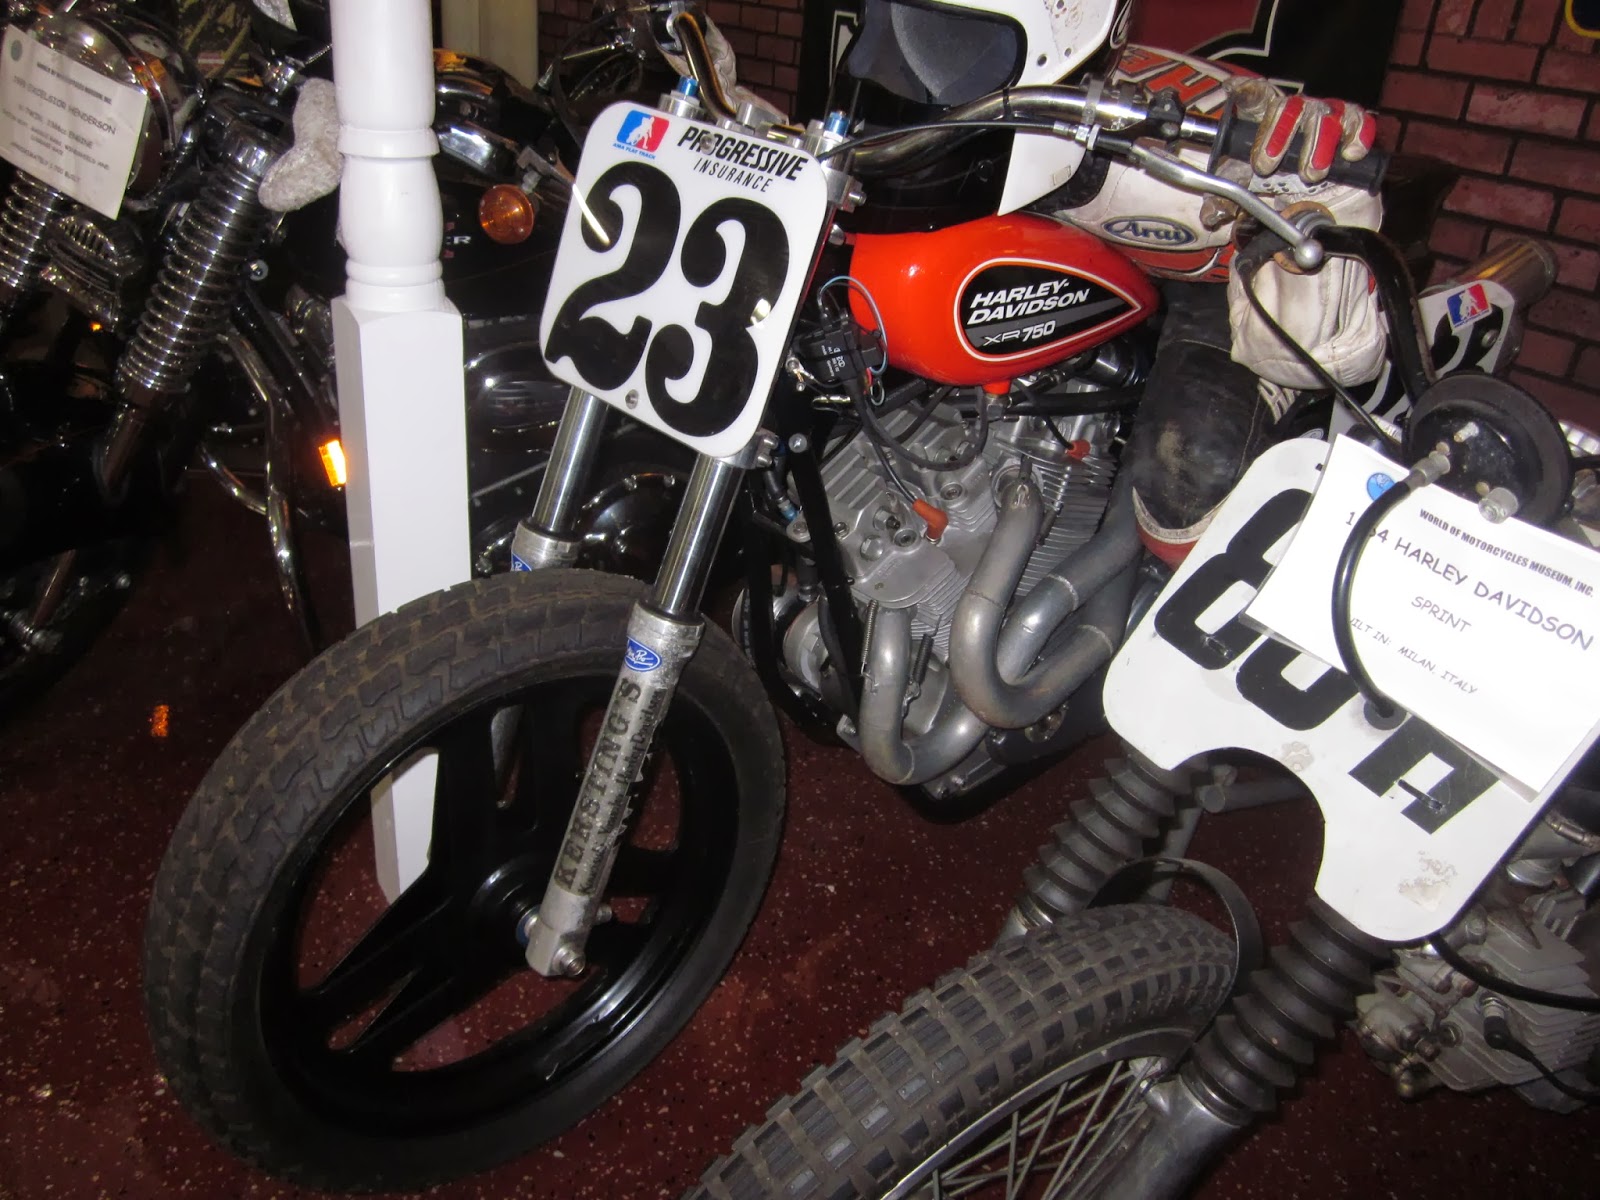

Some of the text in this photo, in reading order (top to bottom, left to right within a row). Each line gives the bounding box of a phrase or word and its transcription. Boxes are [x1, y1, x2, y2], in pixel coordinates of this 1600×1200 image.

[68, 105, 117, 135] HENDERSON
[693, 157, 774, 194] INSURANCE
[1120, 220, 1183, 242] Arai
[544, 160, 791, 438] 23
[967, 289, 1090, 325] DAVIDSON
[970, 279, 1070, 309] HARLEY-
[1419, 508, 1450, 535] WORLD
[1449, 525, 1462, 540] OF
[1460, 530, 1529, 569] MOTORCYCLES
[1573, 579, 1594, 598] INC.
[1394, 537, 1469, 586] HARLEY
[1473, 581, 1594, 651] DAVIDSON
[1411, 596, 1472, 633] SPRINT
[1373, 630, 1391, 646] IN:
[1441, 670, 1478, 695] ITALY
